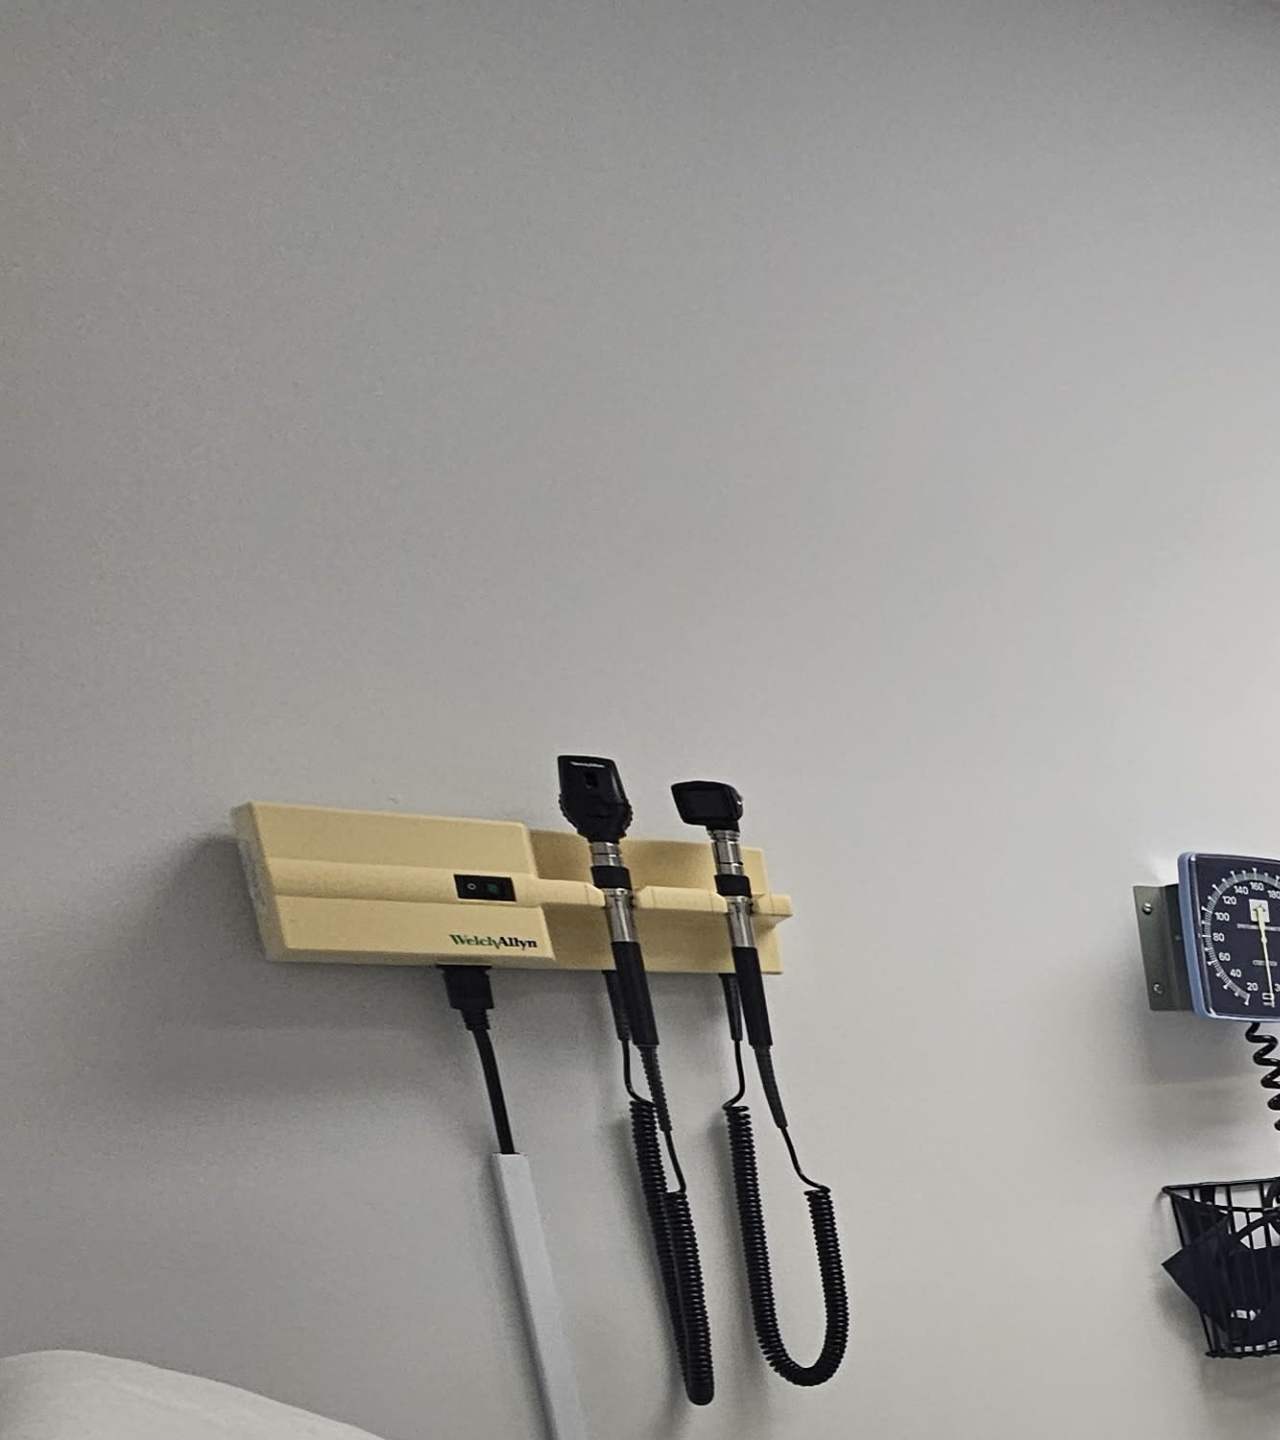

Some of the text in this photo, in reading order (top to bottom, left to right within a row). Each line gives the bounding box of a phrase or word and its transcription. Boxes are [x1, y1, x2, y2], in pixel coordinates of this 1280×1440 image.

[1234, 885, 1249, 895] 140
[1222, 896, 1237, 905] 120
[1215, 912, 1230, 921] 100
[1213, 932, 1225, 942] 80
[1219, 952, 1231, 961] 60
[1230, 968, 1242, 977] 40
[1247, 982, 1259, 991] 20
